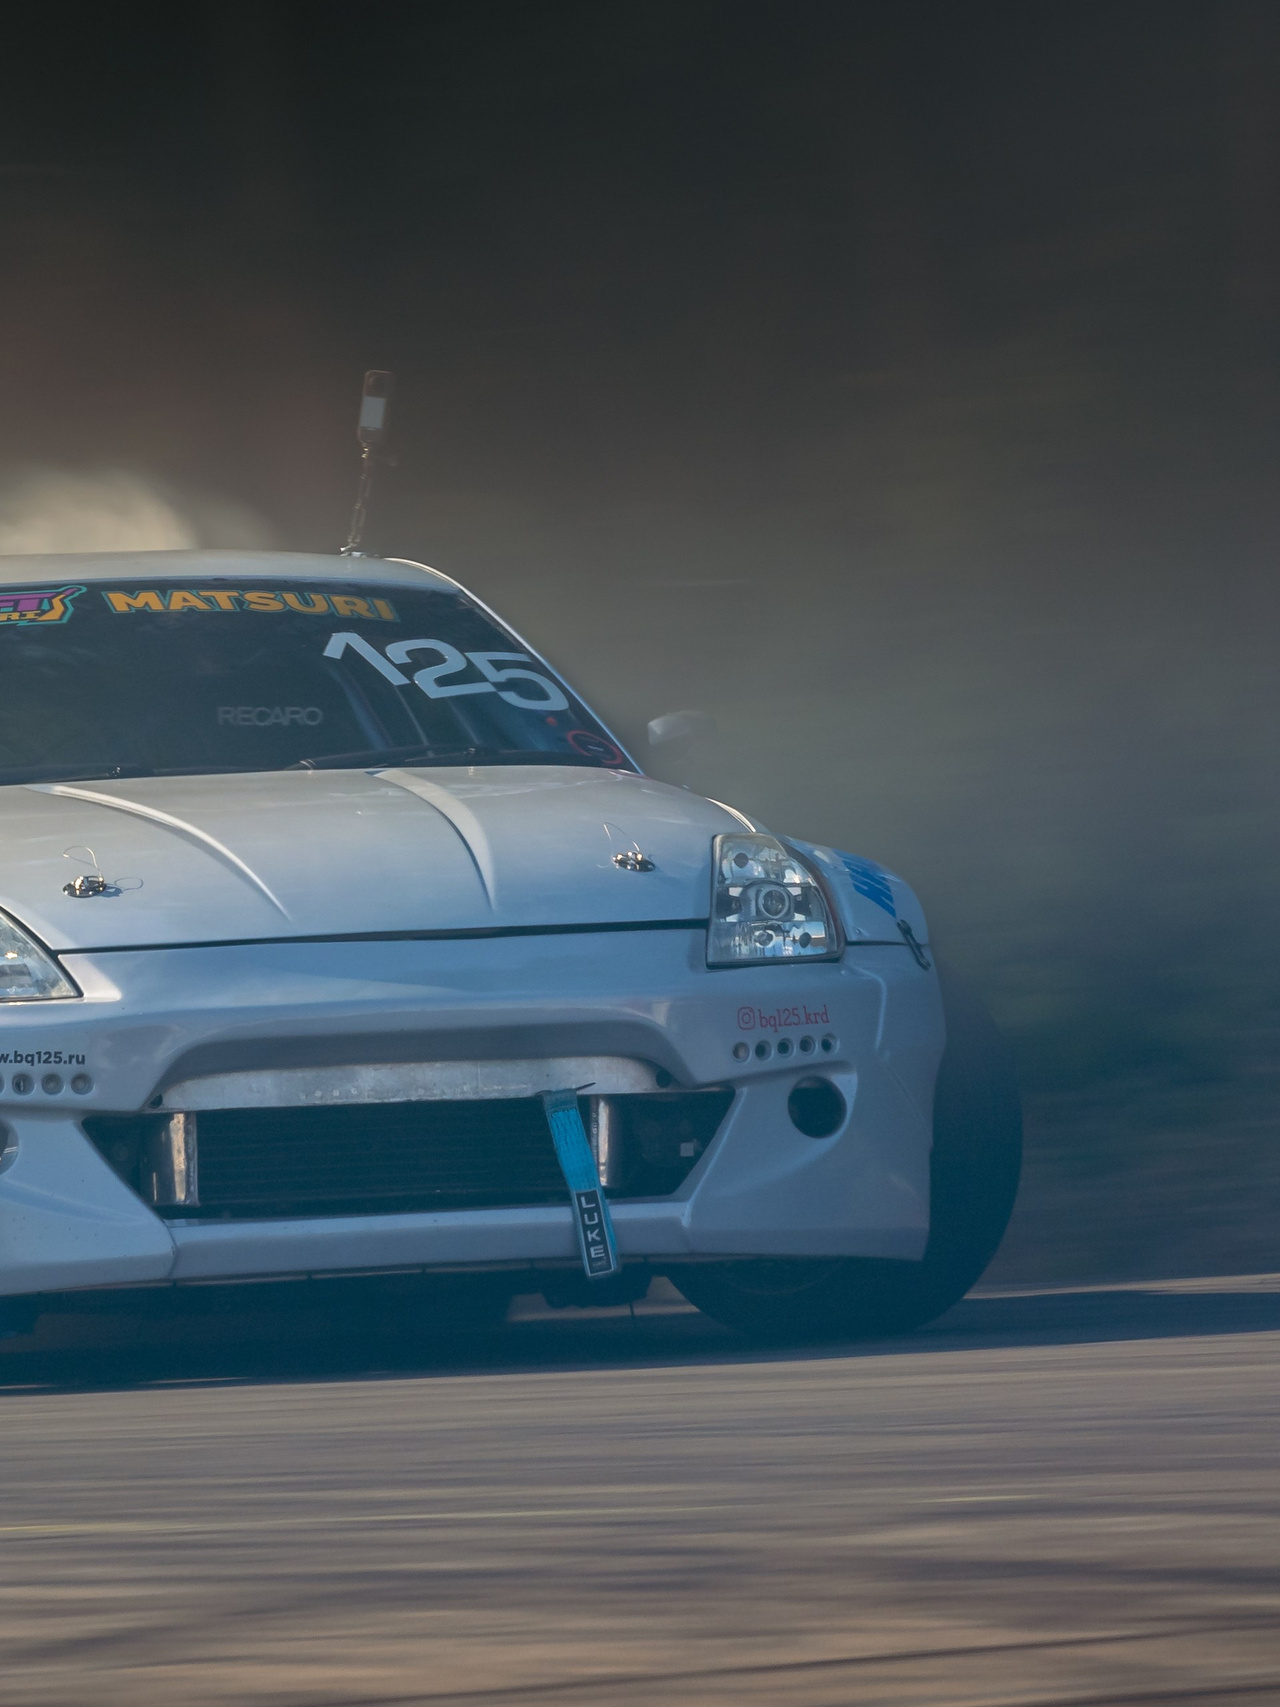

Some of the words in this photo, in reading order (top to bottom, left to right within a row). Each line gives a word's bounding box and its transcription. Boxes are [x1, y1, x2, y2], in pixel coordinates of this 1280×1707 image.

[111, 590, 395, 621] MATSURI
[323, 632, 568, 711] 125
[218, 706, 323, 726] RECARO
[581, 1195, 606, 1259] LUKE
